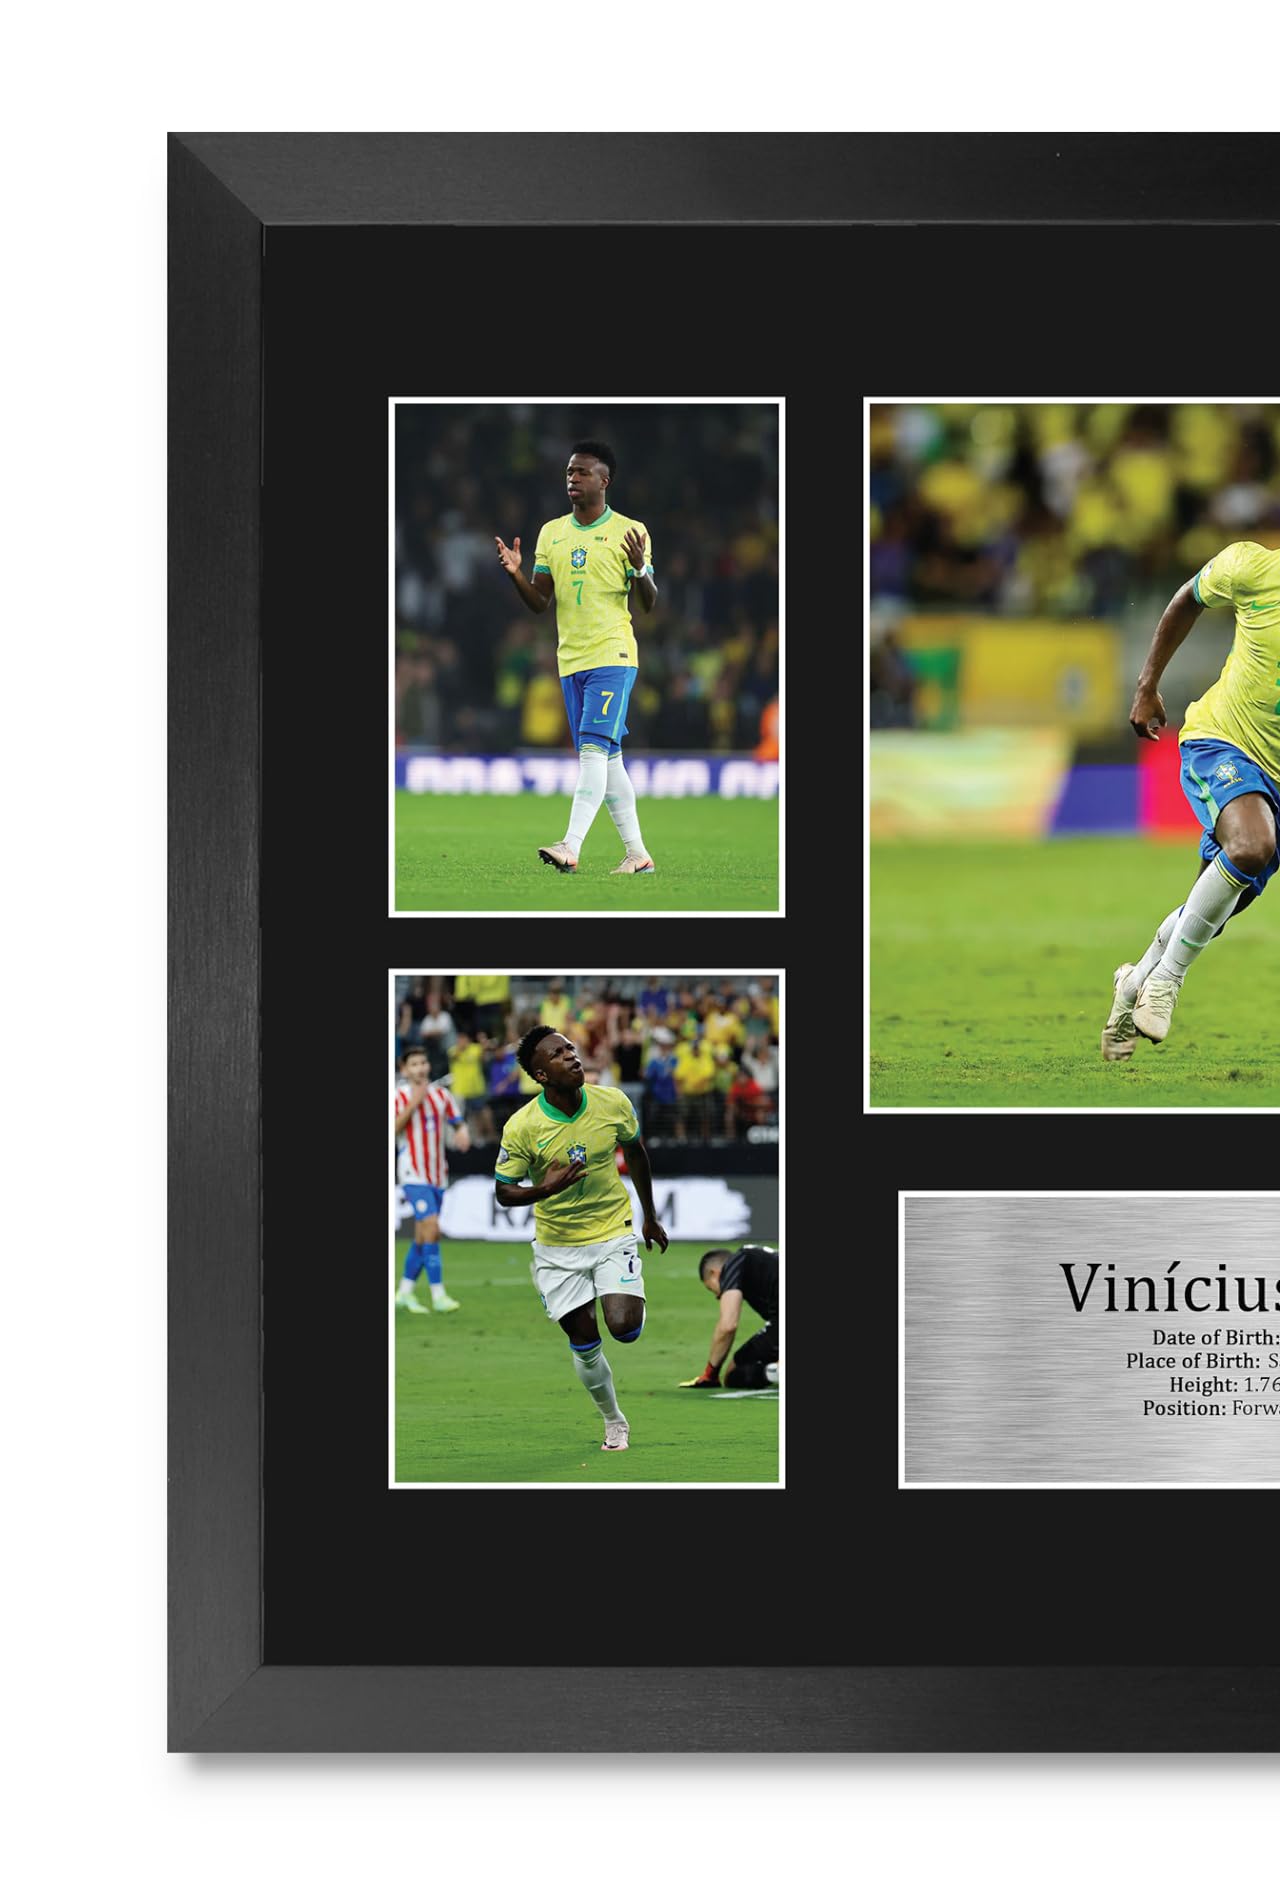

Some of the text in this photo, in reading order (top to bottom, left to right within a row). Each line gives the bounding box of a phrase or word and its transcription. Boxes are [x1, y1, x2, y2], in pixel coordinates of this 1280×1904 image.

[572, 580, 584, 606] 7
[601, 690, 615, 716] 7
[1153, 1329, 1196, 1345] Date
[1201, 1328, 1222, 1345] of
[1226, 1328, 1280, 1345] Birth:
[1127, 1352, 1176, 1369] Place
[1182, 1352, 1203, 1369] of
[1206, 1352, 1260, 1369] Birth:
[1170, 1376, 1238, 1397] Height:
[1143, 1400, 1226, 1416] Position:
